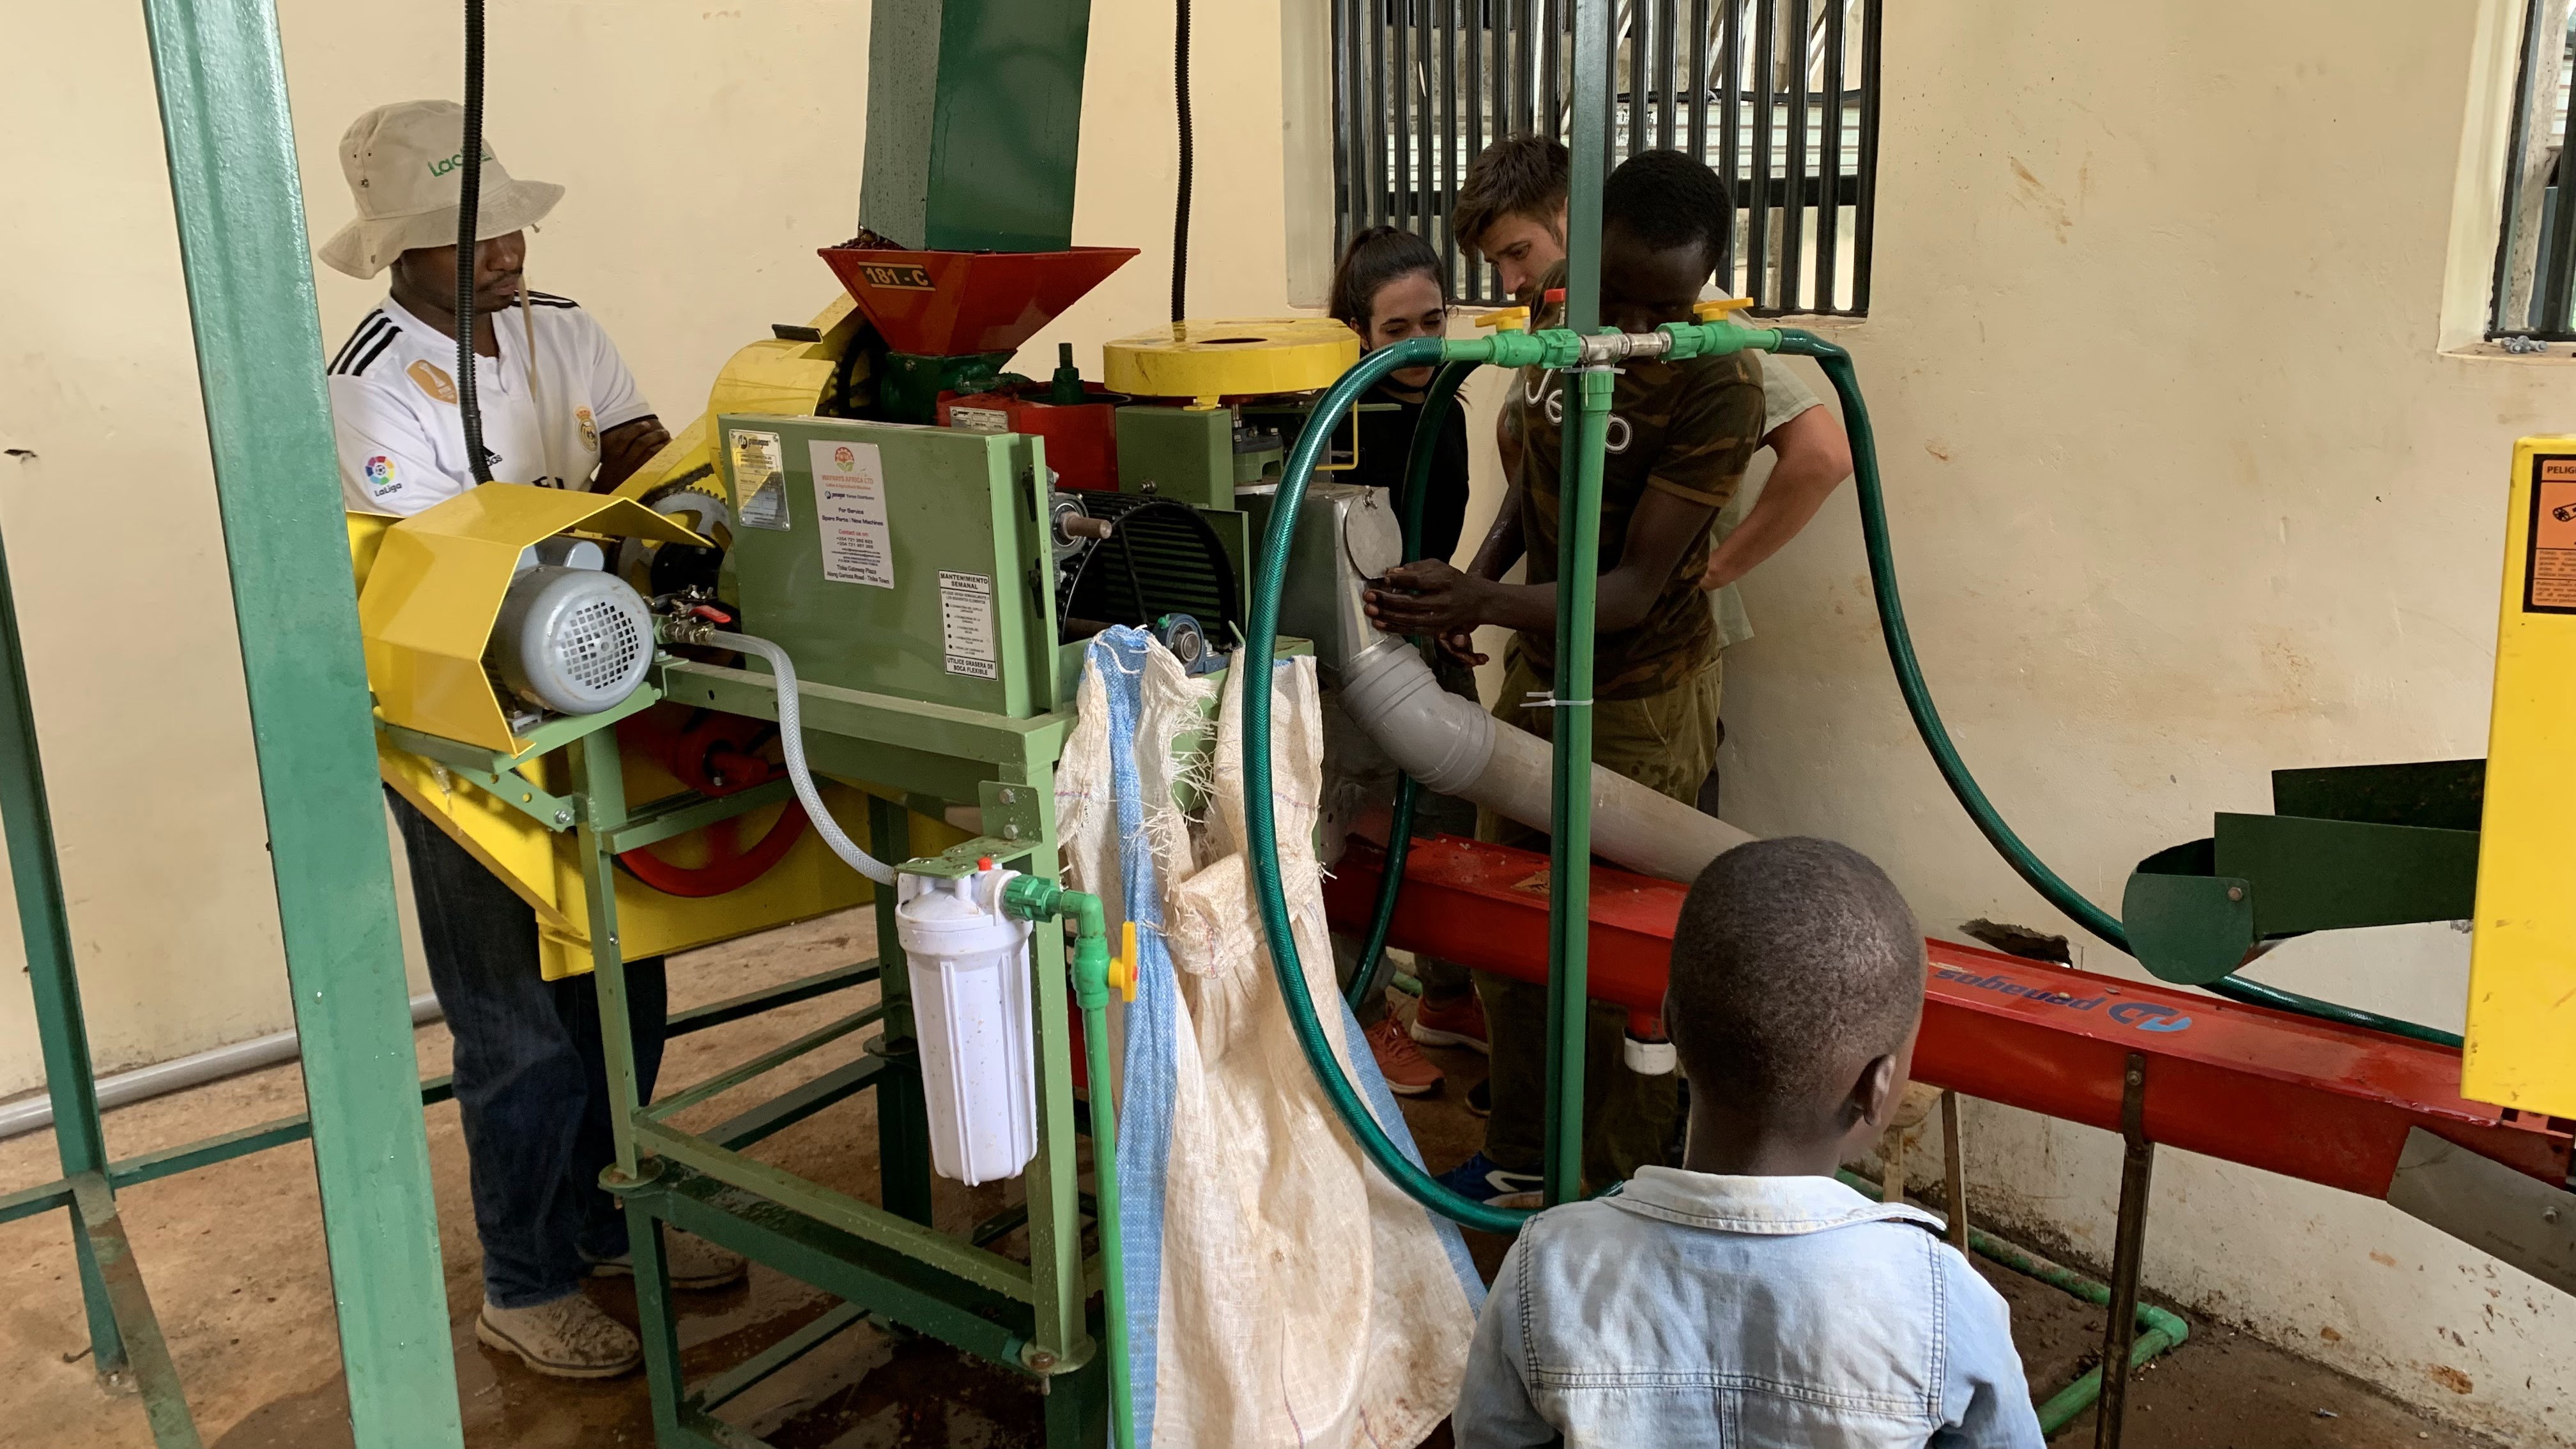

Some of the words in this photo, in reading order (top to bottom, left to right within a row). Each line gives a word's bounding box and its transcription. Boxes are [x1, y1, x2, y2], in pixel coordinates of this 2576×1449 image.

[866, 267, 900, 284] 181
[912, 269, 928, 286] C
[2547, 466, 2576, 474] PELIG
[374, 483, 402, 496] LaLiga
[940, 573, 988, 584] MANTENIMIENTO
[951, 581, 978, 590] SEMANAL
[965, 660, 986, 668] GRASERA
[967, 667, 988, 675] FLEXIBLE
